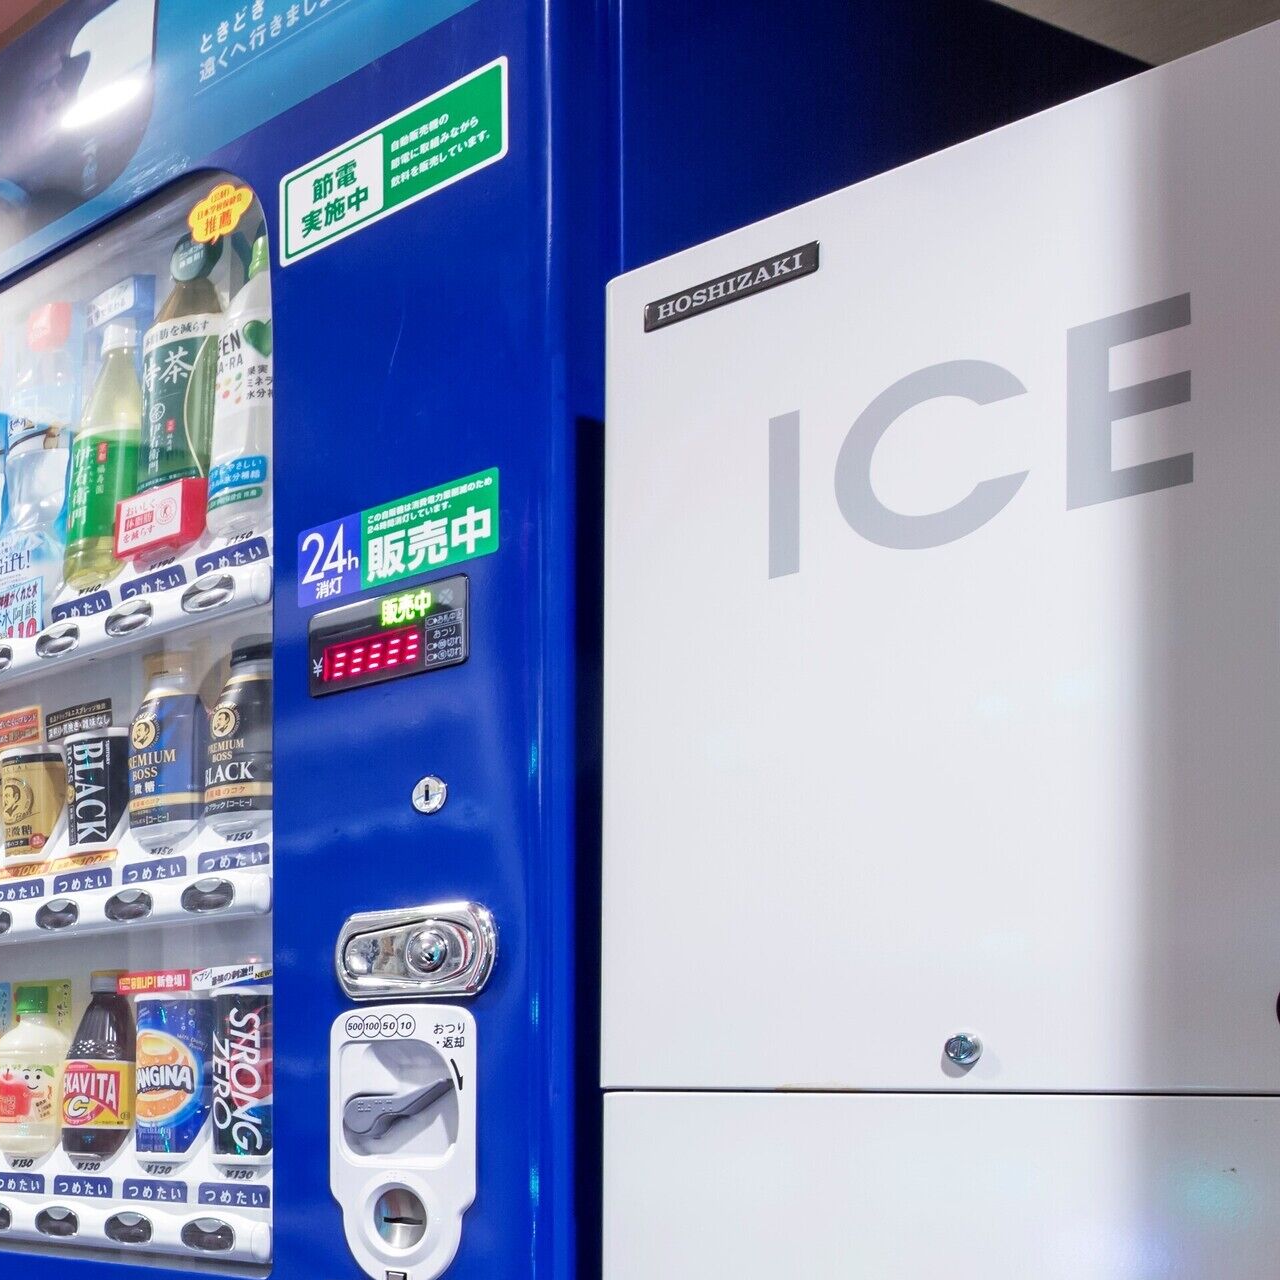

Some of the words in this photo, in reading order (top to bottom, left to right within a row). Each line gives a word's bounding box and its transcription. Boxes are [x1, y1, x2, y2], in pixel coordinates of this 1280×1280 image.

[312, 159, 358, 204] 節電
[301, 187, 370, 238] 実施中
[656, 252, 804, 322] HOSHIZAKI
[247, 364, 269, 376] 果実
[768, 291, 1195, 580] ICE
[301, 523, 359, 585] 24h
[367, 506, 491, 582] 販売中
[202, 545, 263, 571] つめたい
[126, 574, 182, 596] つめたい
[315, 576, 343, 599] 消灯
[57, 598, 107, 619] つめたい
[381, 589, 432, 627] 販売中
[433, 627, 456, 640] おつり
[128, 748, 177, 771] REMIUM
[212, 751, 234, 764] BOSS
[132, 766, 158, 782] BOSS
[72, 739, 109, 845] BLACK
[128, 863, 182, 882] つめたい
[204, 851, 263, 871] つめたい
[58, 875, 108, 892] つめたい
[433, 1021, 466, 1036] おつり
[136, 1063, 195, 1094] ANGINA
[212, 1030, 232, 1130] ZERO
[229, 1006, 263, 1151] STRONG
[59, 1181, 108, 1196] つめたい
[128, 1185, 182, 1201] つめたい
[204, 1188, 264, 1207] つめたい
